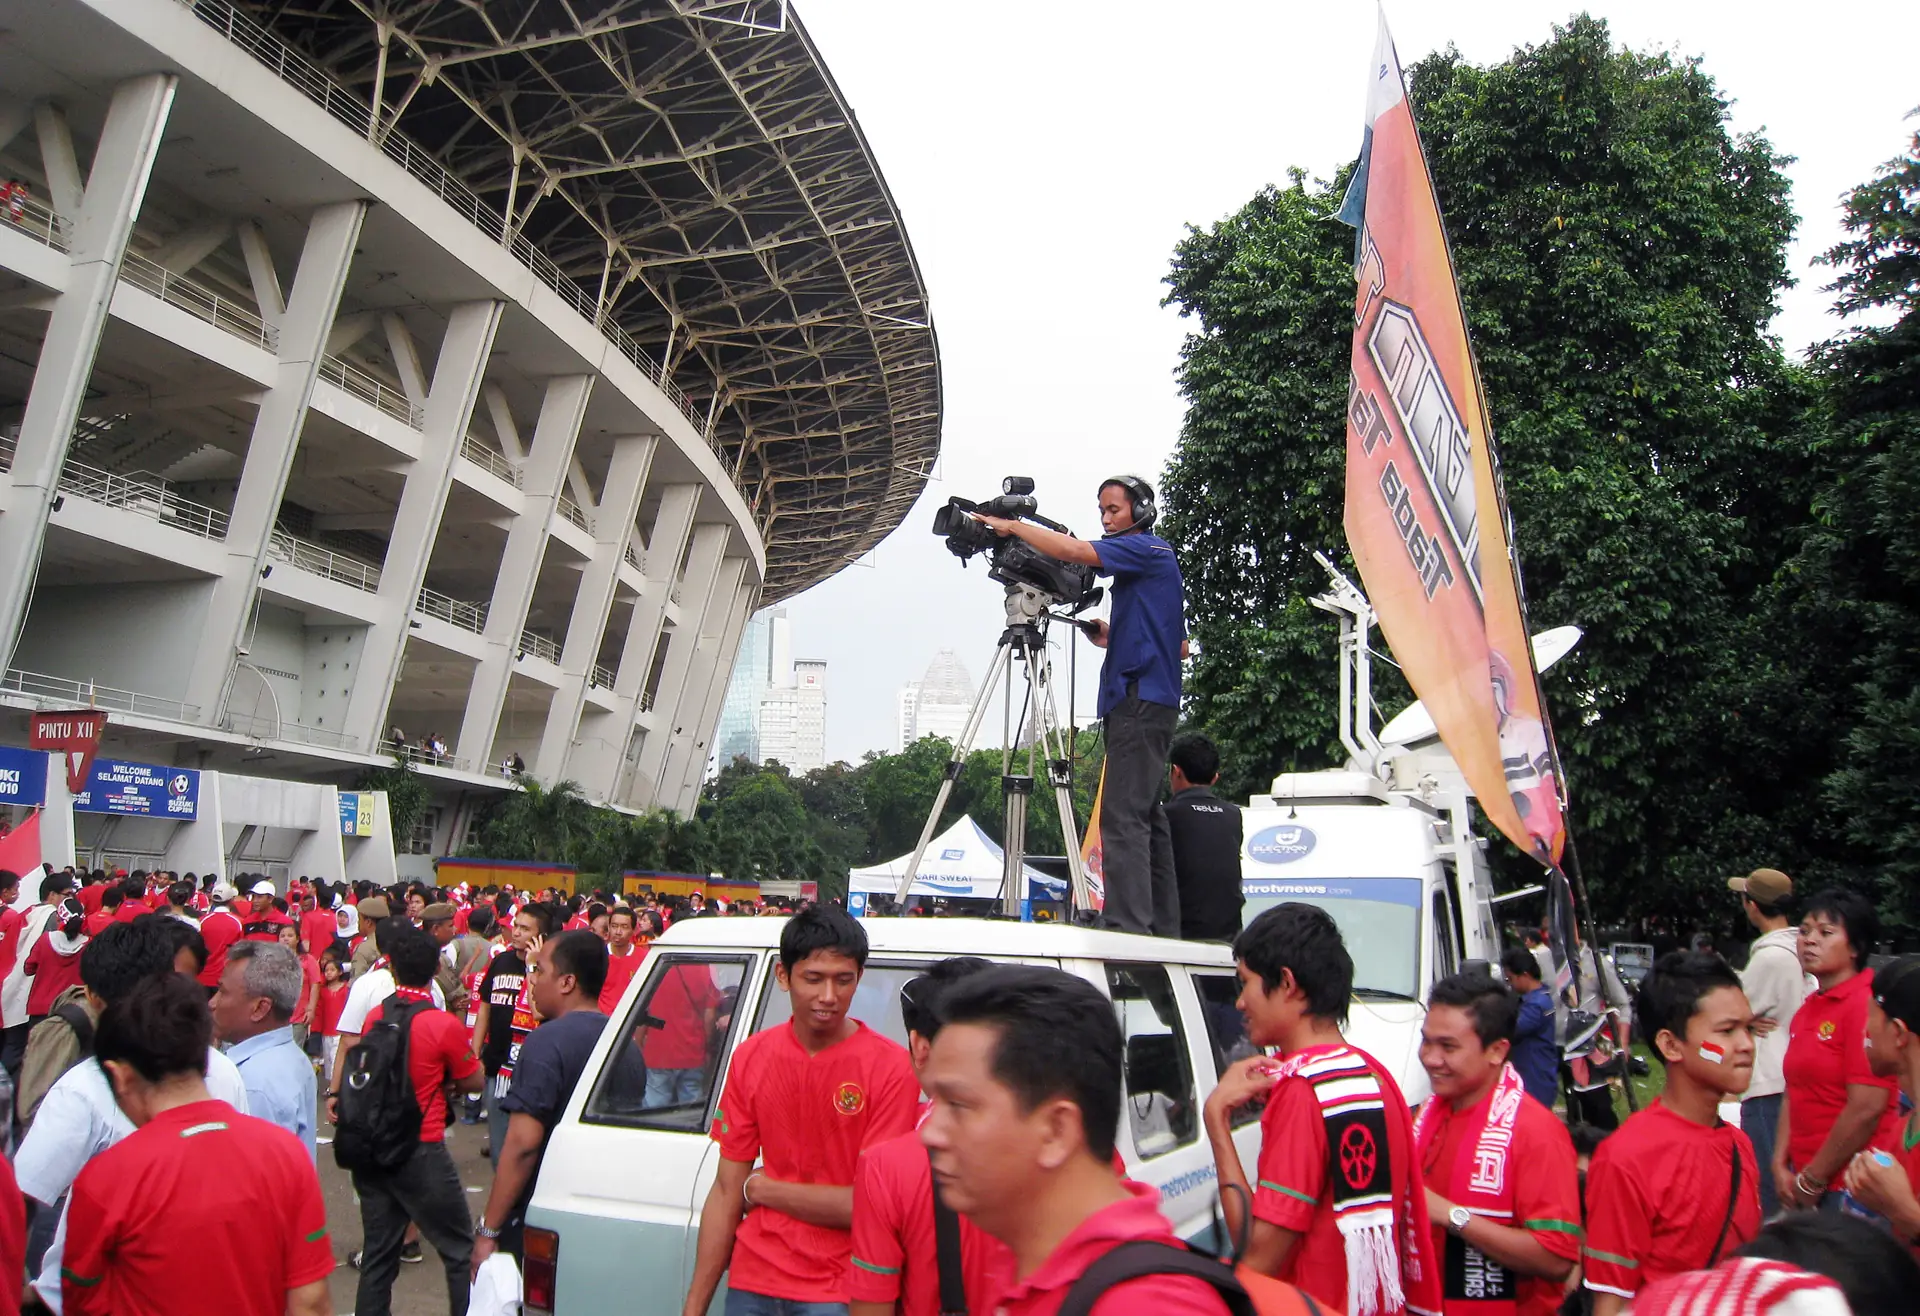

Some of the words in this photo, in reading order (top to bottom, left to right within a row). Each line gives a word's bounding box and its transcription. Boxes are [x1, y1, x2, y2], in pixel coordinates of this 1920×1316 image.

[39, 722, 71, 739] PINTU
[77, 721, 93, 738] XII
[113, 765, 152, 776] WELCOME
[98, 772, 133, 783] SELAMAT
[135, 776, 164, 787] DATANG
[168, 805, 182, 813] CUP
[169, 800, 194, 808] SUZUKI
[360, 812, 371, 825] 23
